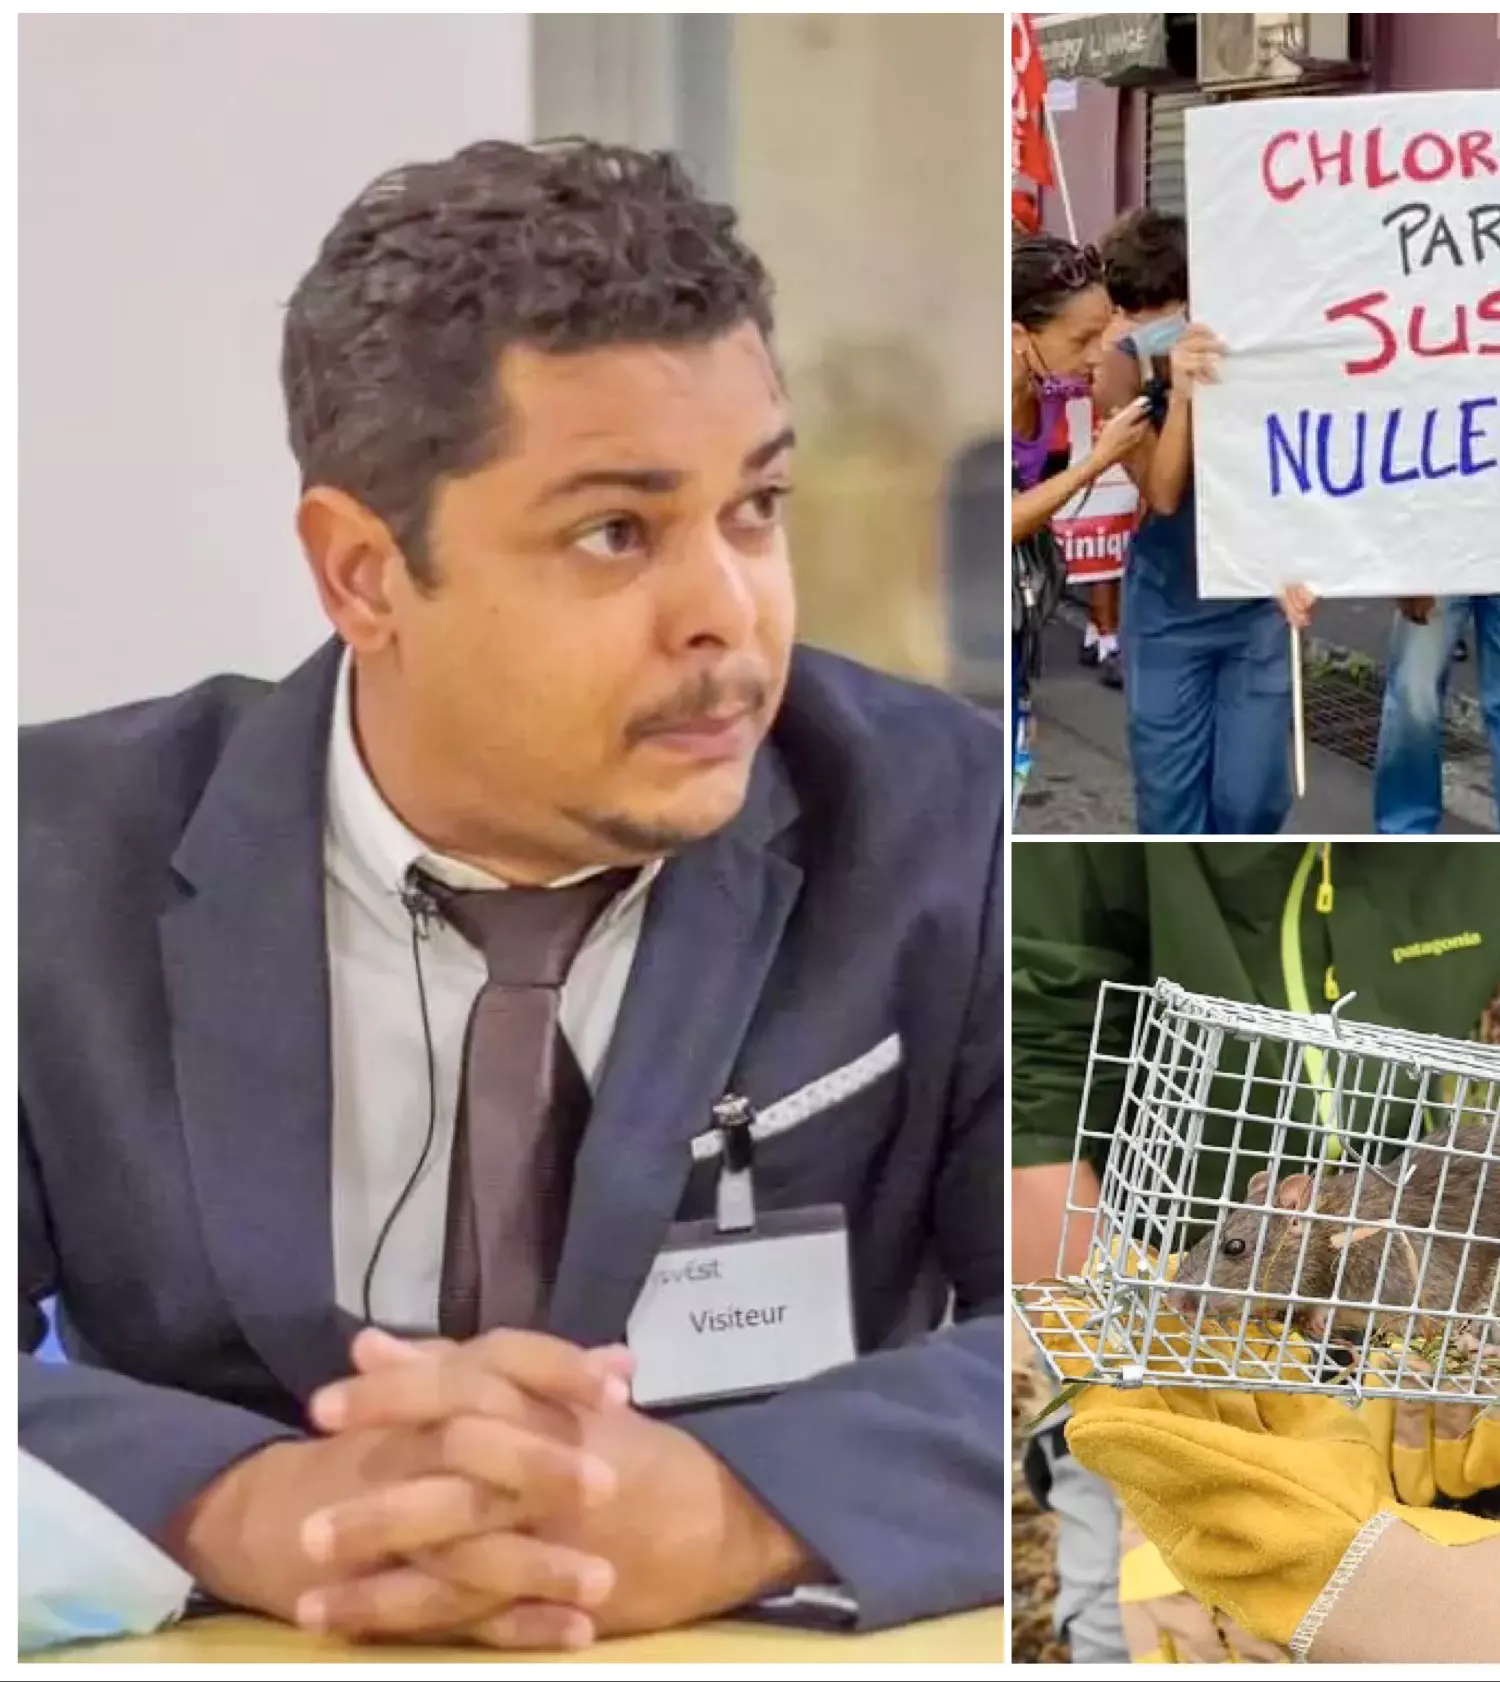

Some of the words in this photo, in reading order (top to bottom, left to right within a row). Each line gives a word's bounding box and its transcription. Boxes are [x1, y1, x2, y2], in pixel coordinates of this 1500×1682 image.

[1265, 397, 1498, 497] NULLE
[1054, 526, 1130, 563] iniq
[1392, 931, 1482, 964] patagonia
[689, 1302, 787, 1333] Visiteur
